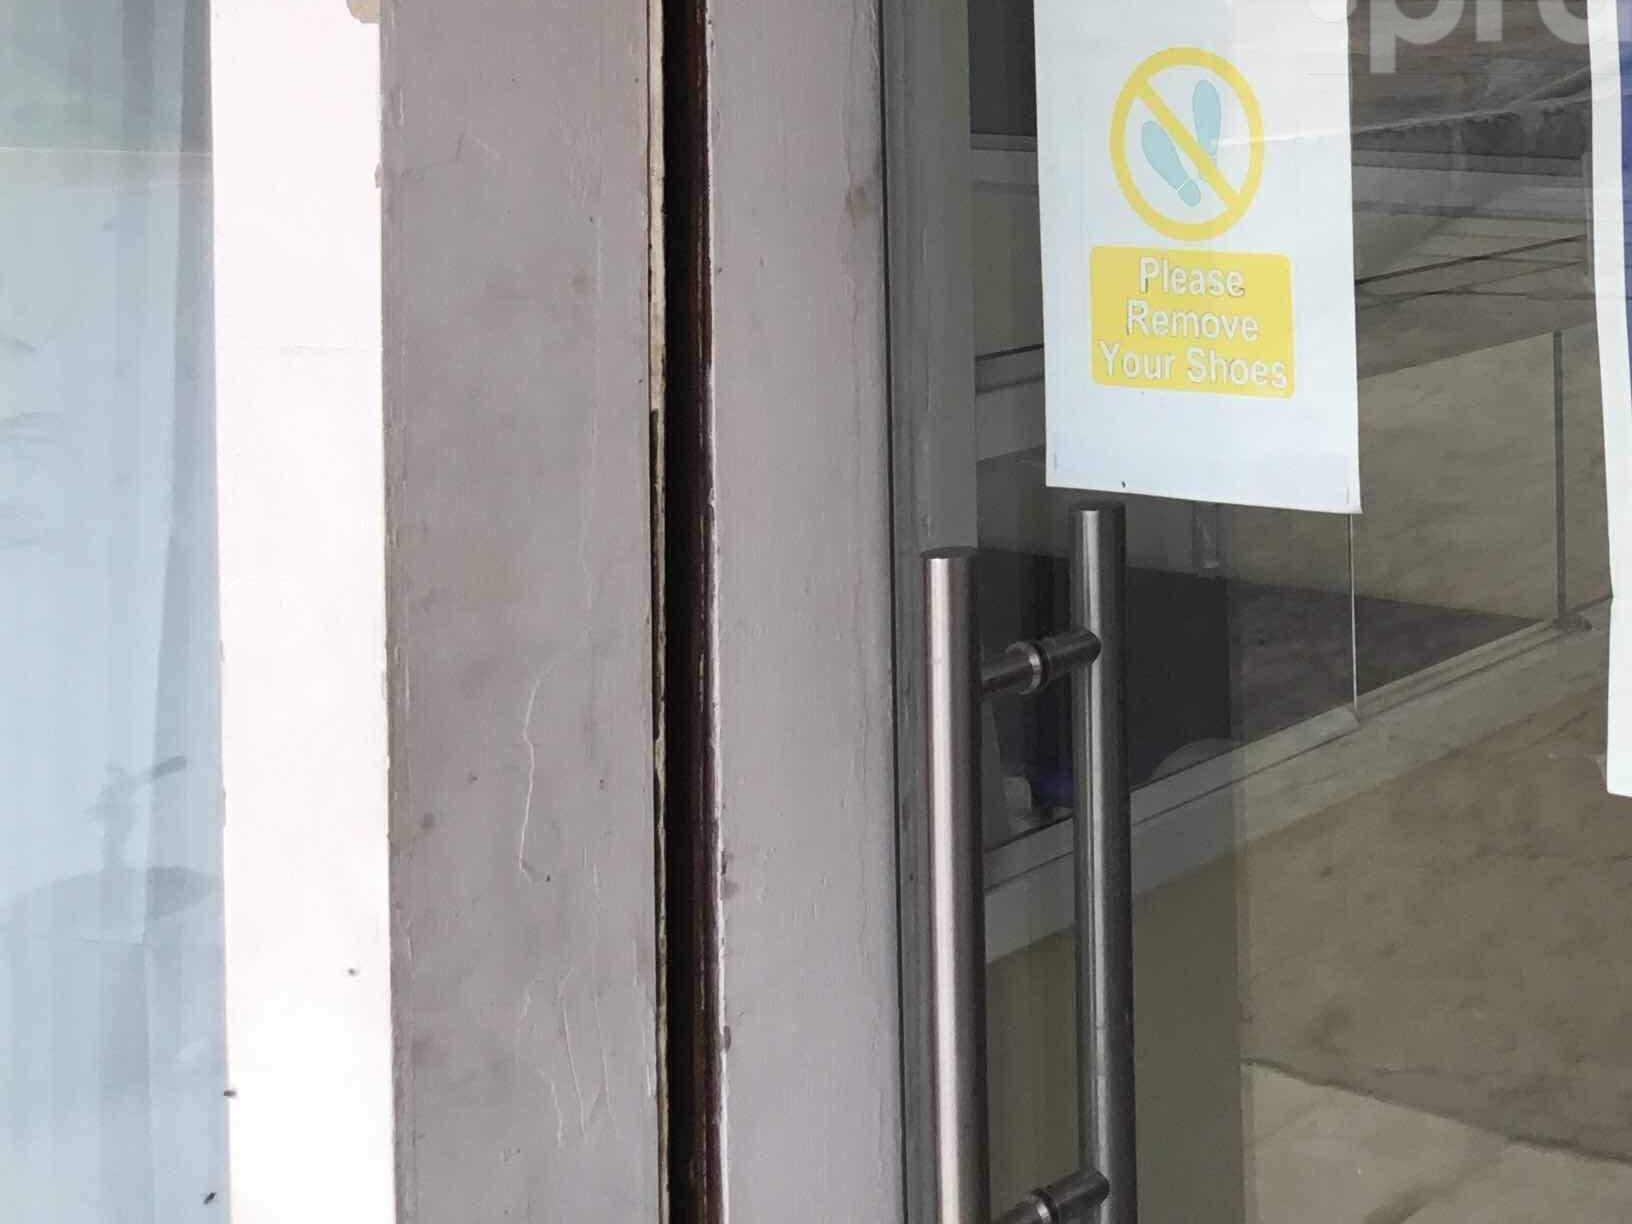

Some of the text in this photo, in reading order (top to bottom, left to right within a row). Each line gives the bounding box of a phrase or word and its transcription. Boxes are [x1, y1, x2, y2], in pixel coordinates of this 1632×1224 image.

[1138, 256, 1246, 297] Please
[1125, 298, 1260, 344] Remove
[1098, 340, 1289, 390] Your Shoes
